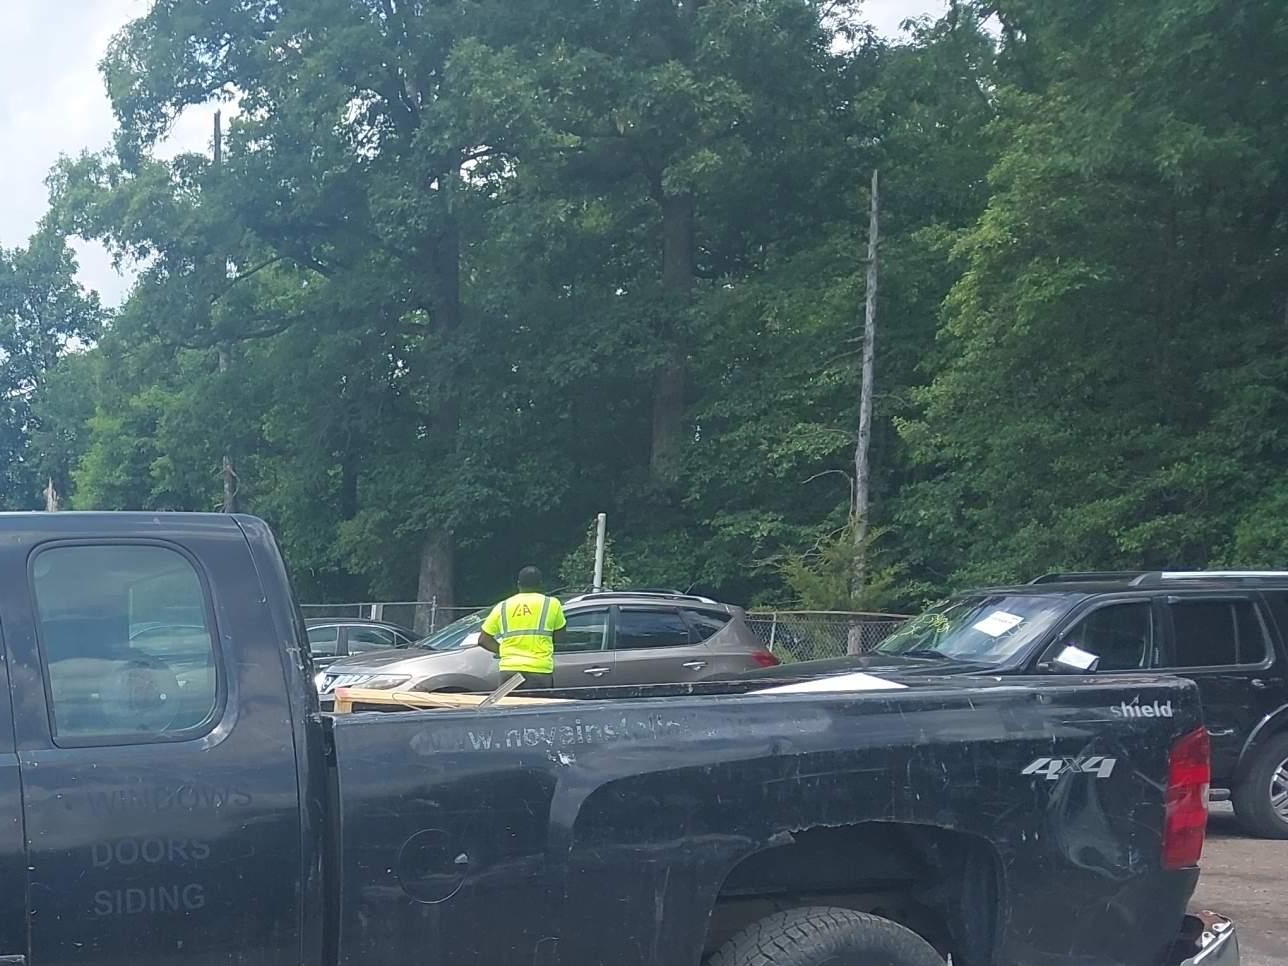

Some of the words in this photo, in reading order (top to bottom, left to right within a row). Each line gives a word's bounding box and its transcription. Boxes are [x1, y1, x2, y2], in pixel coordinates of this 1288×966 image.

[1109, 699, 1175, 718] shield
[90, 838, 211, 867] DOORS
[93, 883, 206, 916] SIDING
